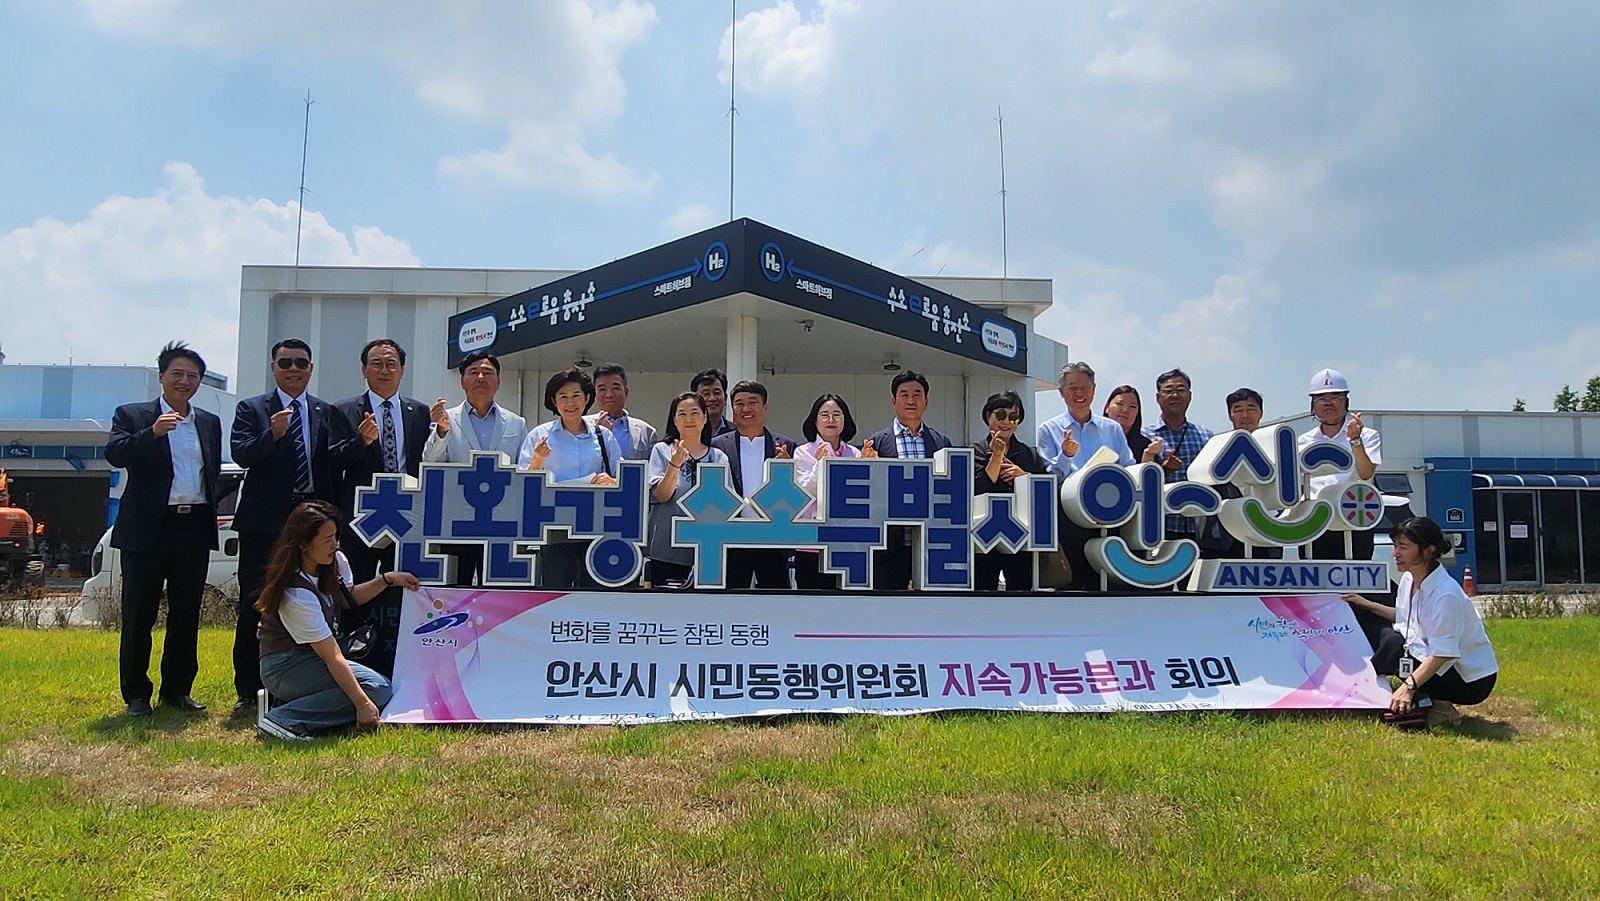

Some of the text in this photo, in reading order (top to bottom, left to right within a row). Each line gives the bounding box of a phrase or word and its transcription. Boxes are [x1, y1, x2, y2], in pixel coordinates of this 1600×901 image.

[1218, 565, 1381, 587] ANSAN CITY
[420, 637, 458, 648] 안산시
[551, 620, 770, 647] 변화를 꿈꾸는 참된 동행
[546, 656, 1242, 701] 안산시 시민동행위원회 지속가능분과 회의
